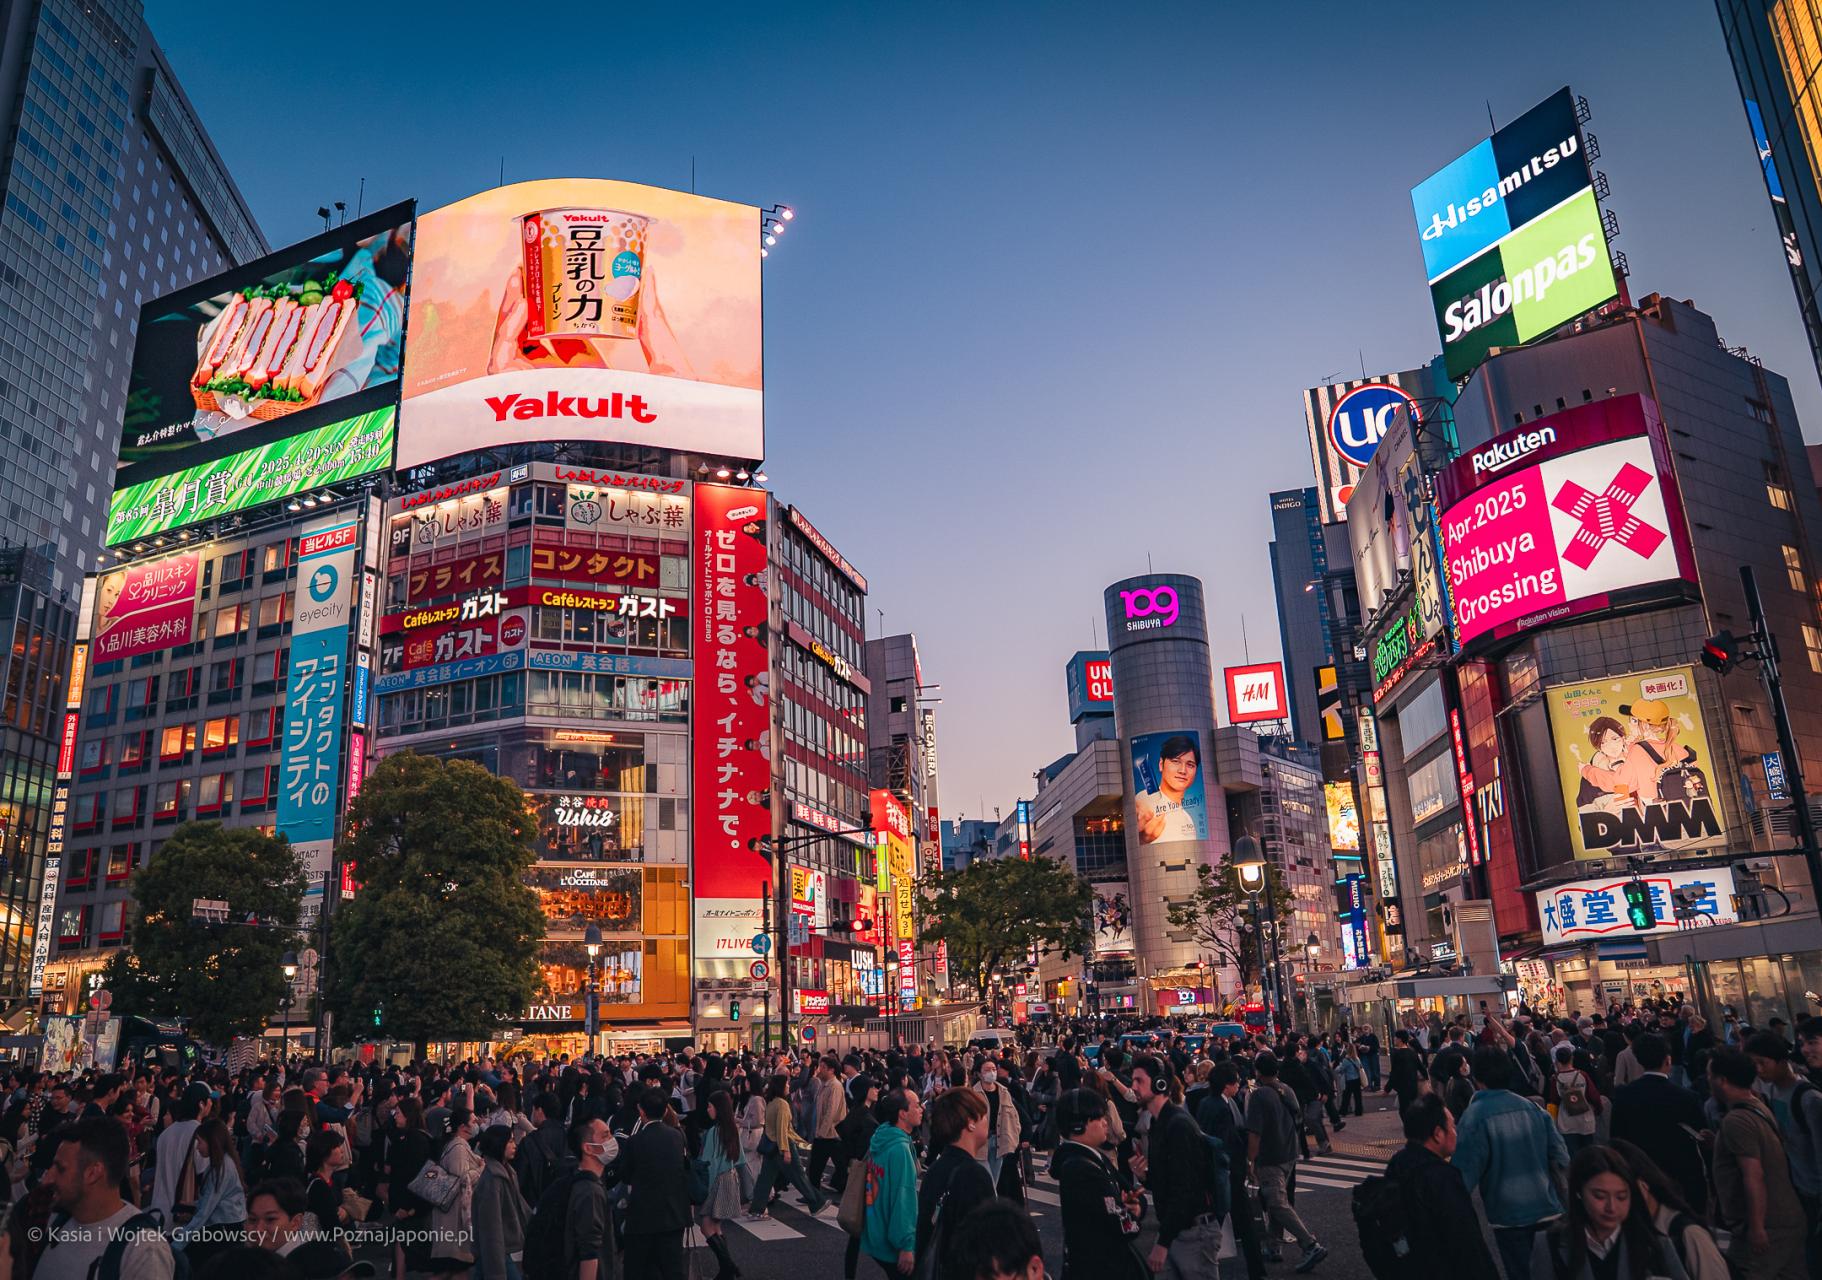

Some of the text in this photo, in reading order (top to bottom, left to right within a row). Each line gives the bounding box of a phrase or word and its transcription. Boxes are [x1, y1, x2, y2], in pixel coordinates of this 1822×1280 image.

[1422, 135, 1577, 241] Hisamitsu
[563, 214, 610, 222] Yakult
[566, 225, 605, 321] 豆乳の力
[551, 282, 563, 320] プレーン
[1446, 233, 1597, 343] Salonpas
[485, 391, 657, 424] Yakult
[1472, 427, 1556, 474] Rakuten
[400, 472, 501, 510] しゃぶしゃぶバイキング
[555, 465, 684, 493] しゃぶしゃぶバイキング
[444, 501, 502, 534] しゃぶ葉
[609, 500, 684, 528] しゃぶ葉
[1274, 501, 1301, 510] INDIGO
[1448, 485, 1527, 547] Apr.2025
[305, 528, 351, 553] 当ビル5F
[392, 528, 410, 545] 9F
[533, 549, 656, 580] コンタクト
[1452, 532, 1536, 586] Shibuya
[142, 563, 195, 588] 品川スキン
[410, 556, 503, 594] プライス
[141, 581, 187, 603] クリニック
[460, 591, 509, 620] ガスト
[1120, 585, 1180, 627] 109
[1459, 568, 1558, 625] Crossing
[300, 603, 344, 623] eyecity
[618, 595, 676, 619] ガスト
[107, 617, 188, 653] 品川美容外科
[503, 626, 524, 639] ガスト
[1126, 618, 1161, 631] SHIBUYA
[382, 646, 403, 665] 7F
[434, 627, 493, 663] ガスト
[381, 675, 405, 688] AEON
[414, 664, 451, 683] 英会話
[453, 658, 498, 674] イーオン
[535, 653, 571, 666] AEON
[581, 655, 630, 672] 英会話
[716, 529, 742, 849] ゼロを見るなら、イチナナで。
[1645, 680, 1683, 693] 映画化!
[286, 658, 318, 808] アイシティ
[312, 655, 339, 806] コンタクトの
[924, 713, 936, 777] BIC CAMERA
[560, 797, 609, 809] 渋谷 焼肉
[1155, 803, 1168, 814] Are
[1167, 799, 1180, 811] You
[1579, 798, 1722, 850] DMM
[49, 843, 62, 851] 5F
[47, 860, 60, 868] 3F
[44, 884, 56, 904] 内科
[716, 939, 752, 949] 17LIVE
[852, 950, 873, 970] LUSH
[520, 1005, 572, 1020] TANE
